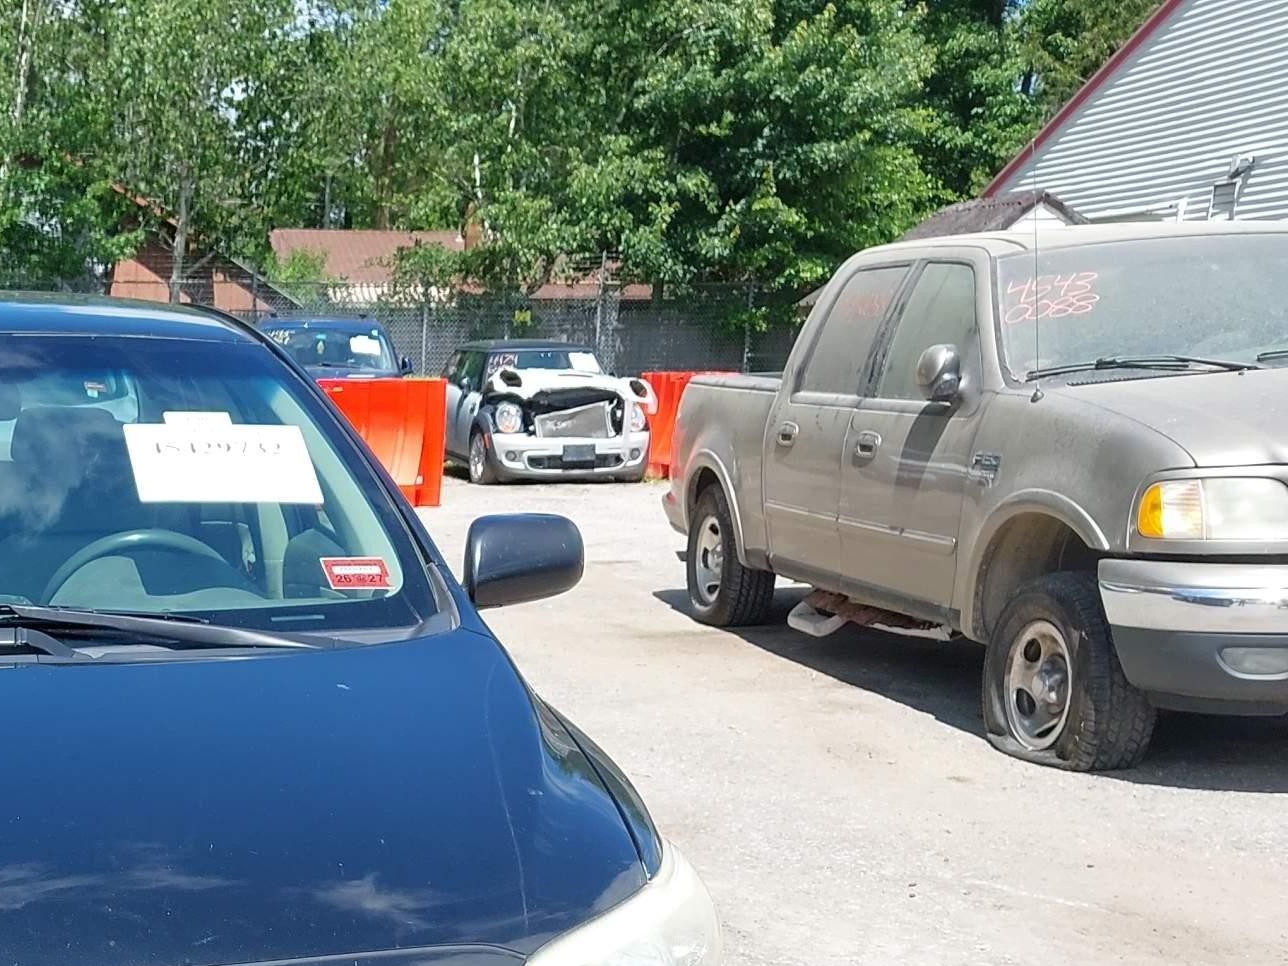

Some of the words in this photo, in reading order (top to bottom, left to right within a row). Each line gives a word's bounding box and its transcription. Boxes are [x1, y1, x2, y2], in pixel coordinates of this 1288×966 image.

[1006, 271, 1098, 303] 4543
[335, 574, 353, 584] 26
[367, 574, 384, 584] 27
